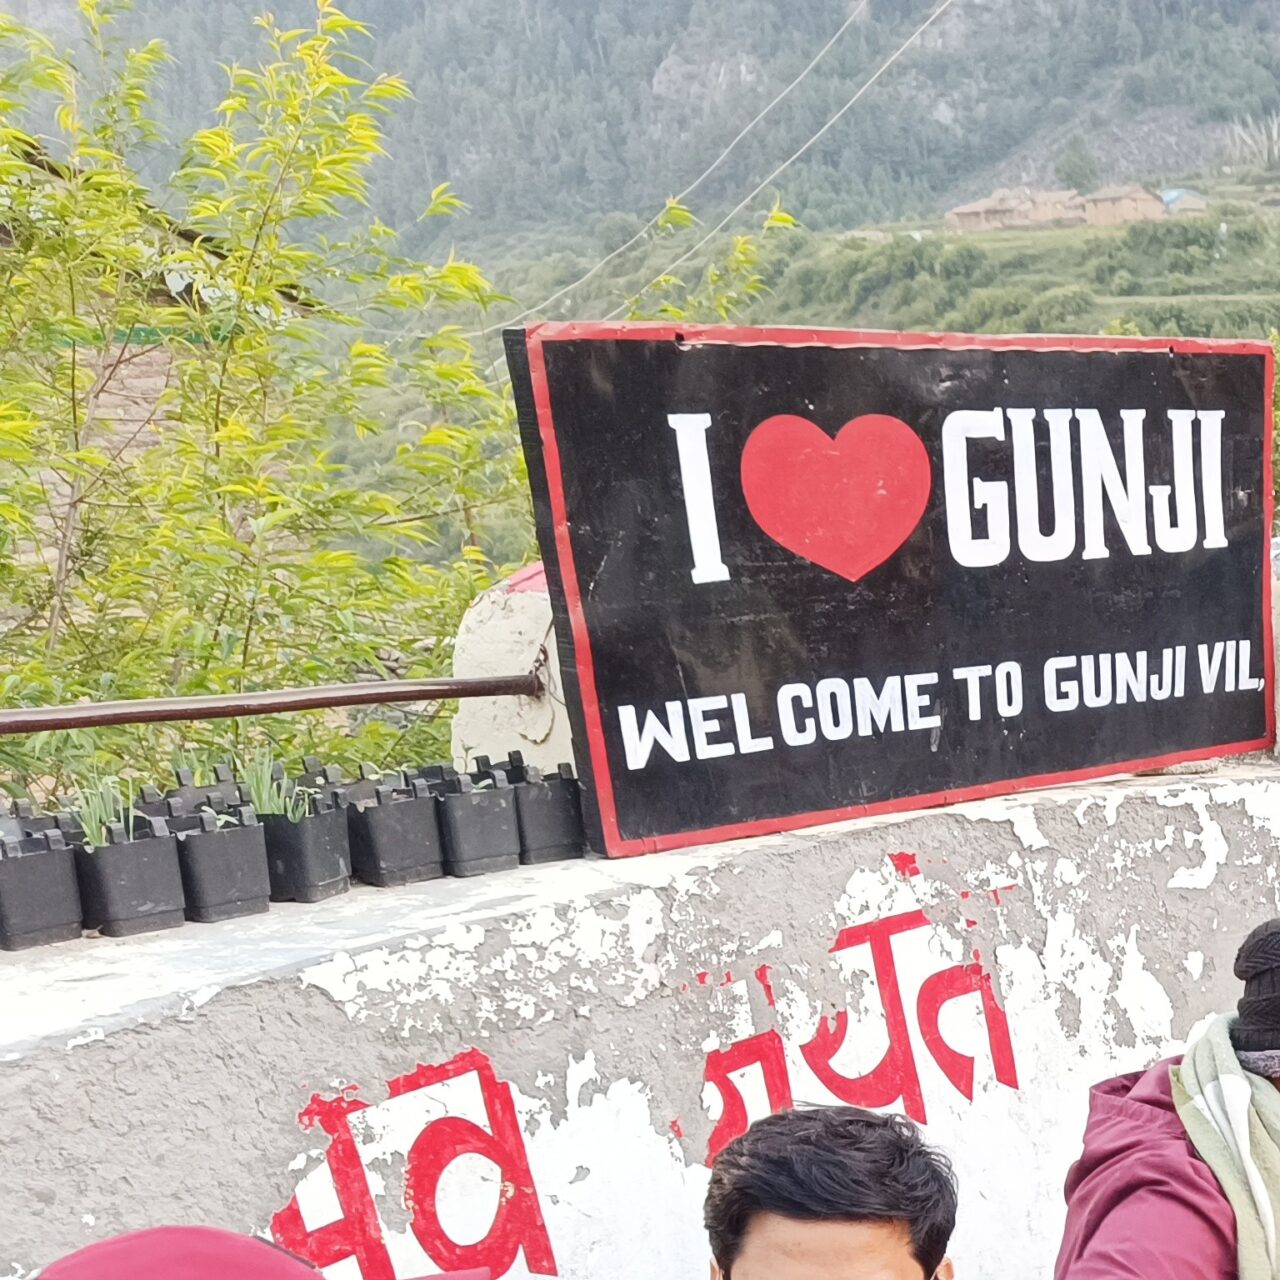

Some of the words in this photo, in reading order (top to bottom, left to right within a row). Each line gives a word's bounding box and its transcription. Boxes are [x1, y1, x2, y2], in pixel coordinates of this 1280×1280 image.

[667, 413, 731, 585] I
[941, 407, 1229, 569] GUNJI
[617, 672, 942, 770] WELCOME
[953, 661, 1023, 721] TO
[1043, 645, 1187, 732] GUNJI
